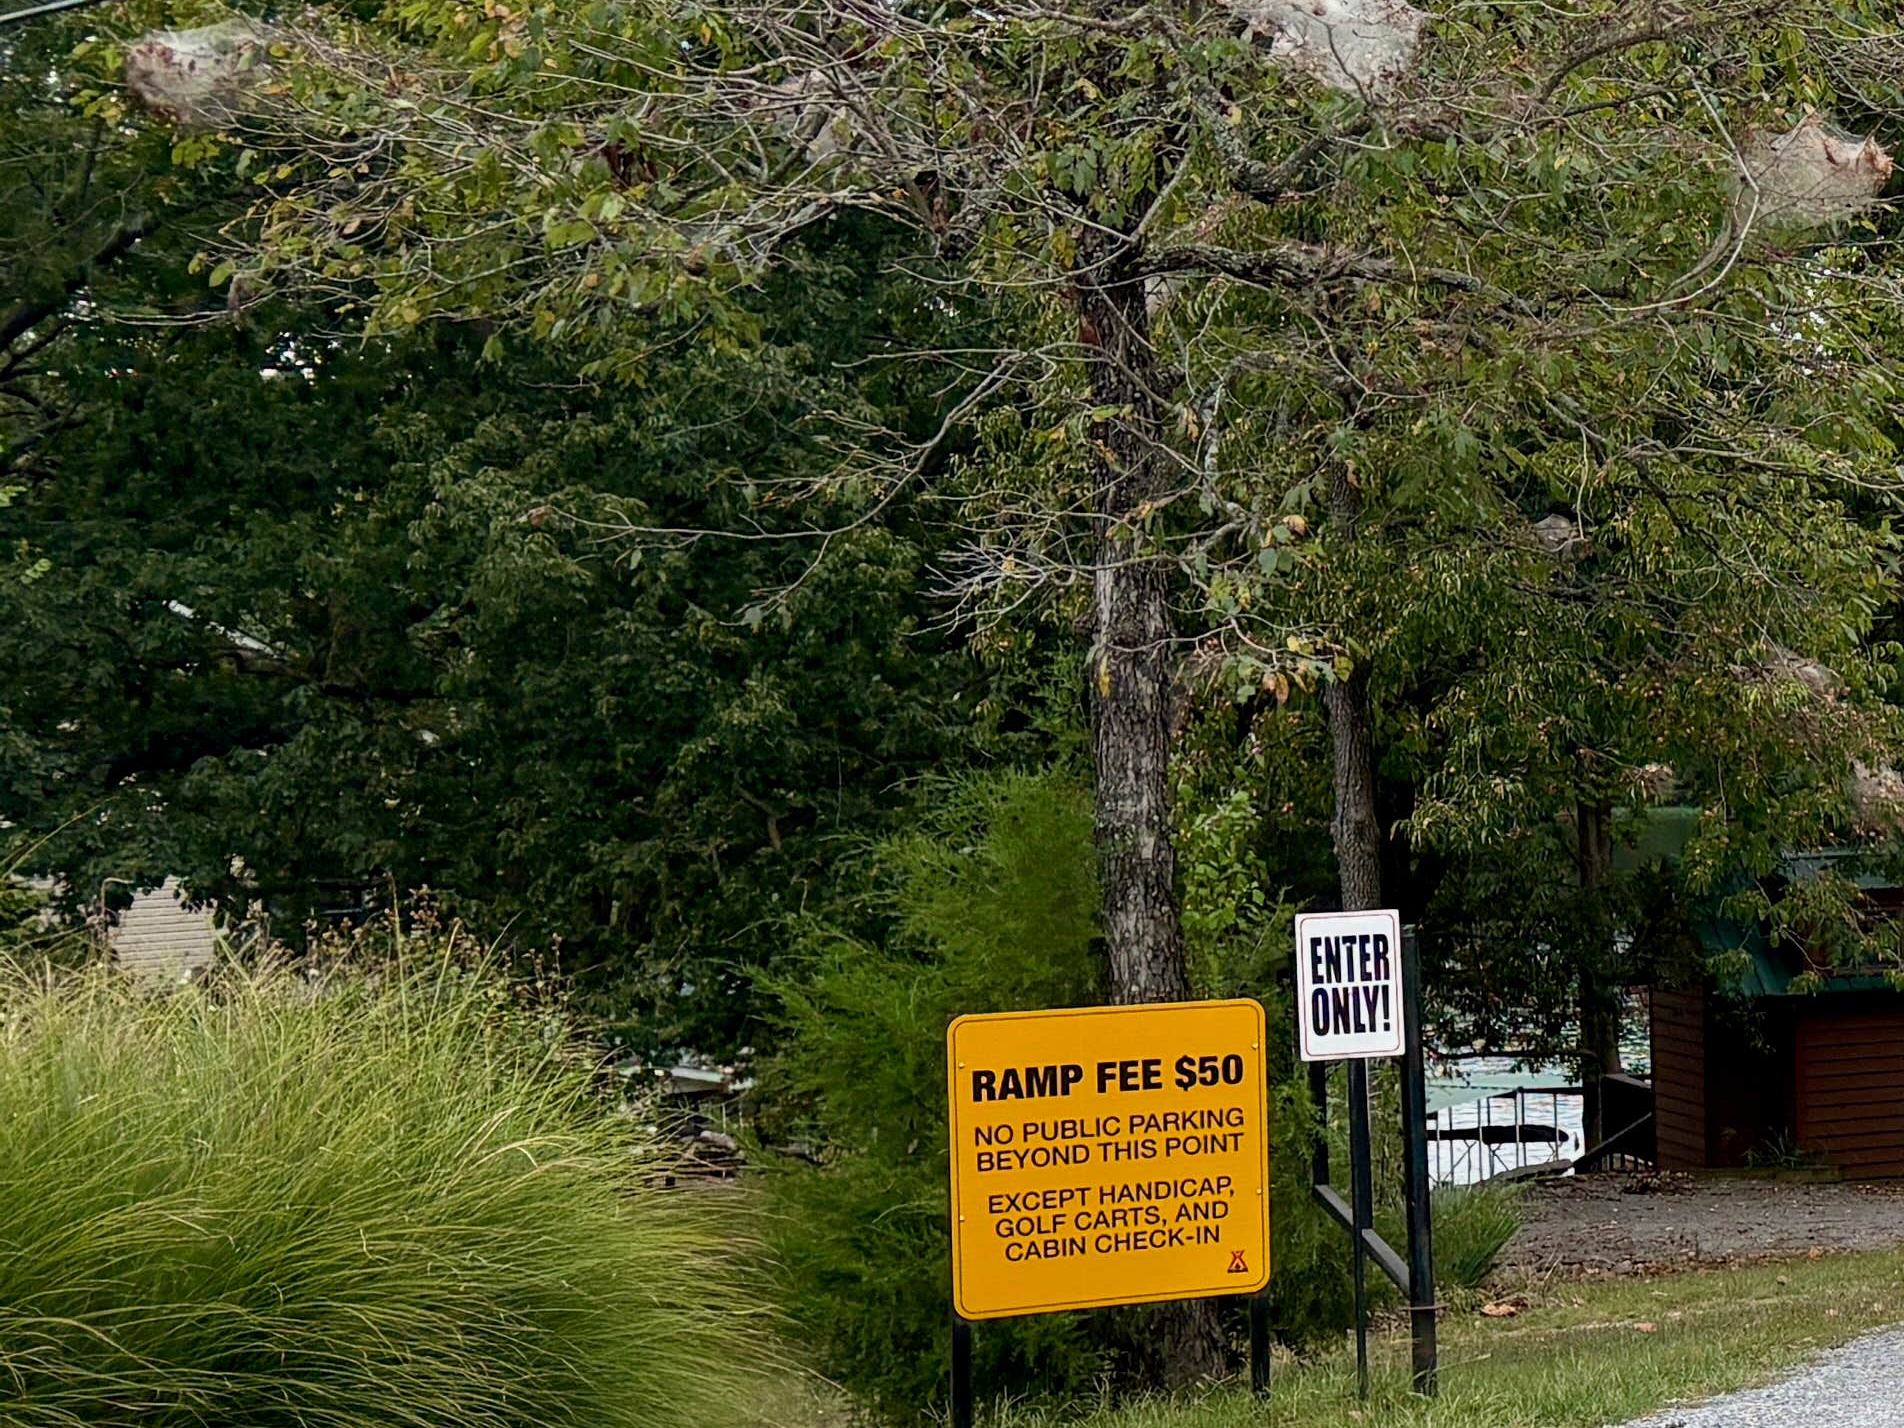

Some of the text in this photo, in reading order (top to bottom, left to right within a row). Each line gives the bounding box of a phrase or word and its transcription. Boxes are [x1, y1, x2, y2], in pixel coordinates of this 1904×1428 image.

[1310, 934, 1390, 985] ENTER
[1312, 984, 1390, 1036] ONLY!
[972, 1054, 1243, 1102] RAMP FEE $50
[974, 1107, 1244, 1147] NO PUBLIC PARKING
[977, 1133, 1244, 1172] BEYOND THIS POINT
[988, 1176, 1235, 1213] EXCEPT HANDICAP,
[995, 1201, 1229, 1238] GOLF CARTS, AND
[1005, 1225, 1220, 1261] CABIN CHECK-IN
